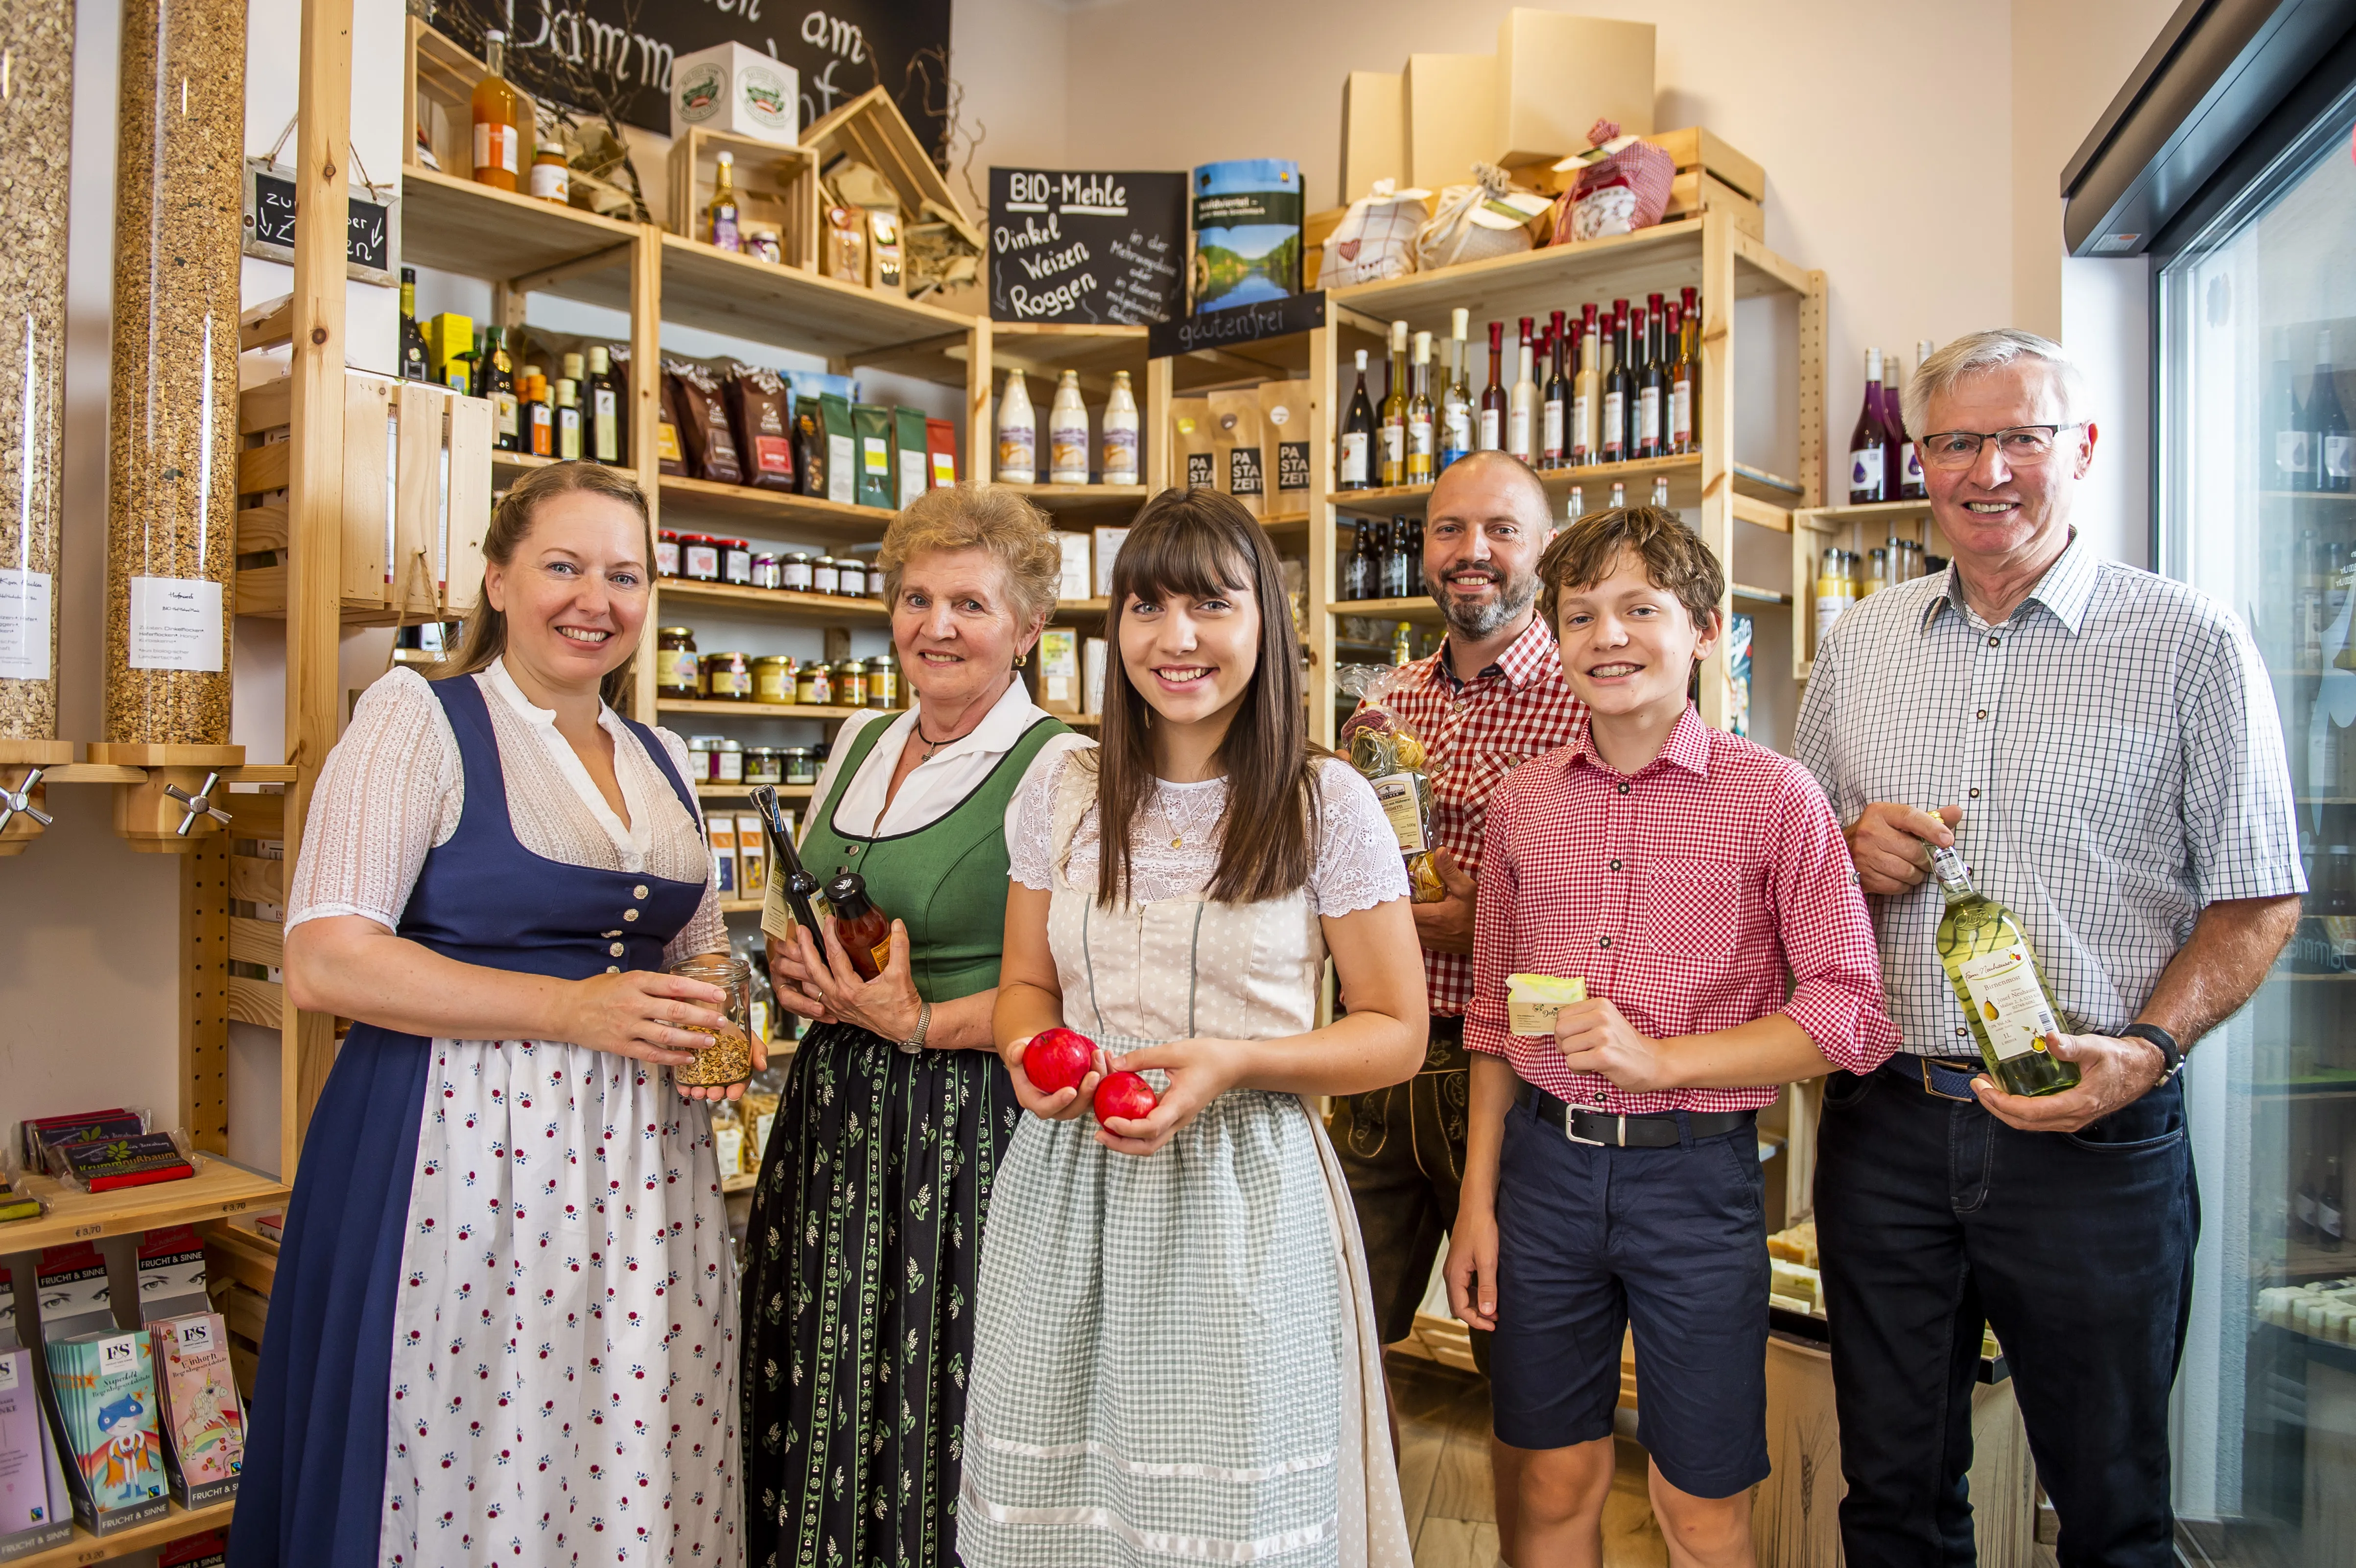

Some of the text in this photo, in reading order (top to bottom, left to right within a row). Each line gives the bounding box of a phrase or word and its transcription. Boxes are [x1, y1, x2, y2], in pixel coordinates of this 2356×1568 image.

[801, 11, 866, 67] am
[1010, 172, 1126, 206] BIO-Mehle
[994, 212, 1061, 254] Dinkel
[1019, 242, 1090, 280] Weizen
[1010, 273, 1097, 319] Roggen
[1178, 302, 1284, 350] glutenfrei
[1232, 452, 1251, 464] PA
[1280, 446, 1299, 459] PA
[1189, 457, 1208, 470] PA
[1233, 465, 1260, 477] STA
[1281, 459, 1308, 472] STA
[1232, 478, 1262, 491] ZEIT
[1384, 804, 1403, 813] PAGHETTI
[1979, 960, 2014, 975] Neuhauser
[1983, 975, 2021, 991] Birnenmost
[1997, 995, 2010, 1005] Josef
[2011, 987, 2037, 998] Neuhauser
[79, 1151, 176, 1171] Krummnußbaum
[230, 1202, 246, 1212] 3,70
[83, 1225, 101, 1237] 3,70
[141, 1257, 171, 1268] FRUCHT
[180, 1251, 202, 1262] SINNE
[41, 1273, 71, 1286] FRUCHT
[82, 1267, 105, 1278] SINNE
[181, 1353, 217, 1369] Einhorn
[103, 1370, 137, 1387] Superheld
[192, 1486, 223, 1502] FRUCHT
[102, 1513, 134, 1530] FRUCHT
[144, 1503, 166, 1518] SINNE
[1, 1527, 71, 1555] FRUCHT & SINNE
[201, 1554, 223, 1566] SINNE
